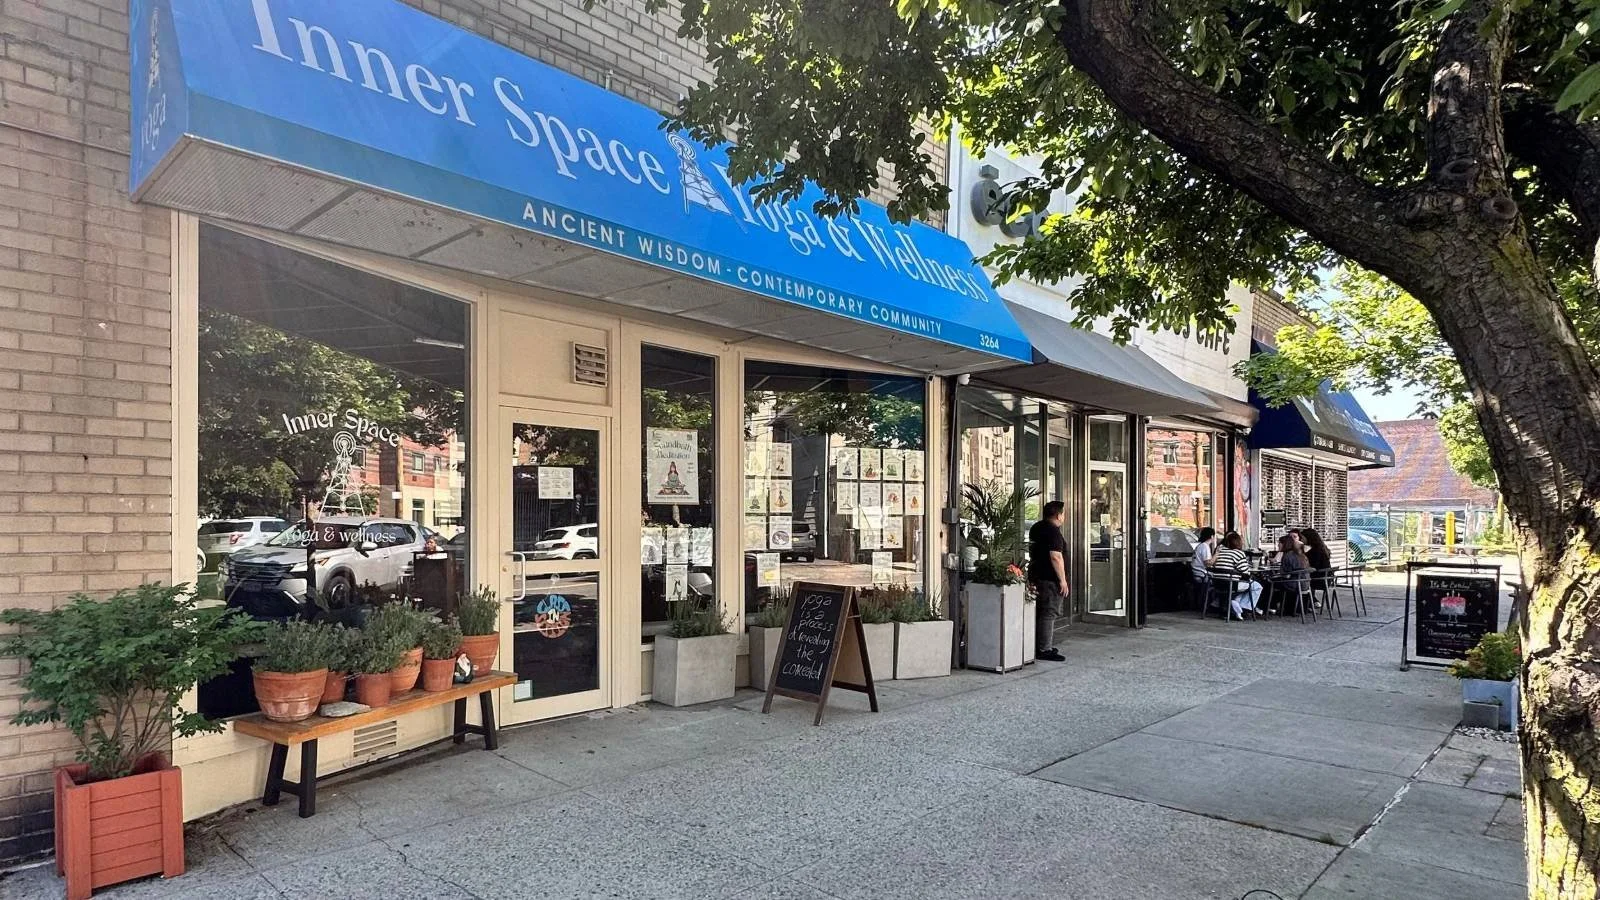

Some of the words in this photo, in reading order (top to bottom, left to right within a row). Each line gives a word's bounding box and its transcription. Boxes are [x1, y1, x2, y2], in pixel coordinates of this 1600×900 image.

[252, 0, 477, 127] Inner
[493, 77, 671, 195] Space
[850, 217, 989, 303] Wellness
[522, 202, 625, 248] ANCIENT
[637, 235, 721, 276] WISDOM
[737, 266, 864, 315] CONTEMPORARY
[870, 304, 942, 336] COMMUNITY
[979, 333, 1000, 350] 3264
[282, 411, 337, 435] Inner
[345, 408, 399, 447] Space
[1156, 493, 1177, 505] MOSS
[324, 524, 336, 542] &
[339, 525, 397, 543] wellness
[801, 608, 811, 619] is
[814, 610, 825, 620] a
[798, 618, 834, 632] process
[796, 644, 814, 661] the
